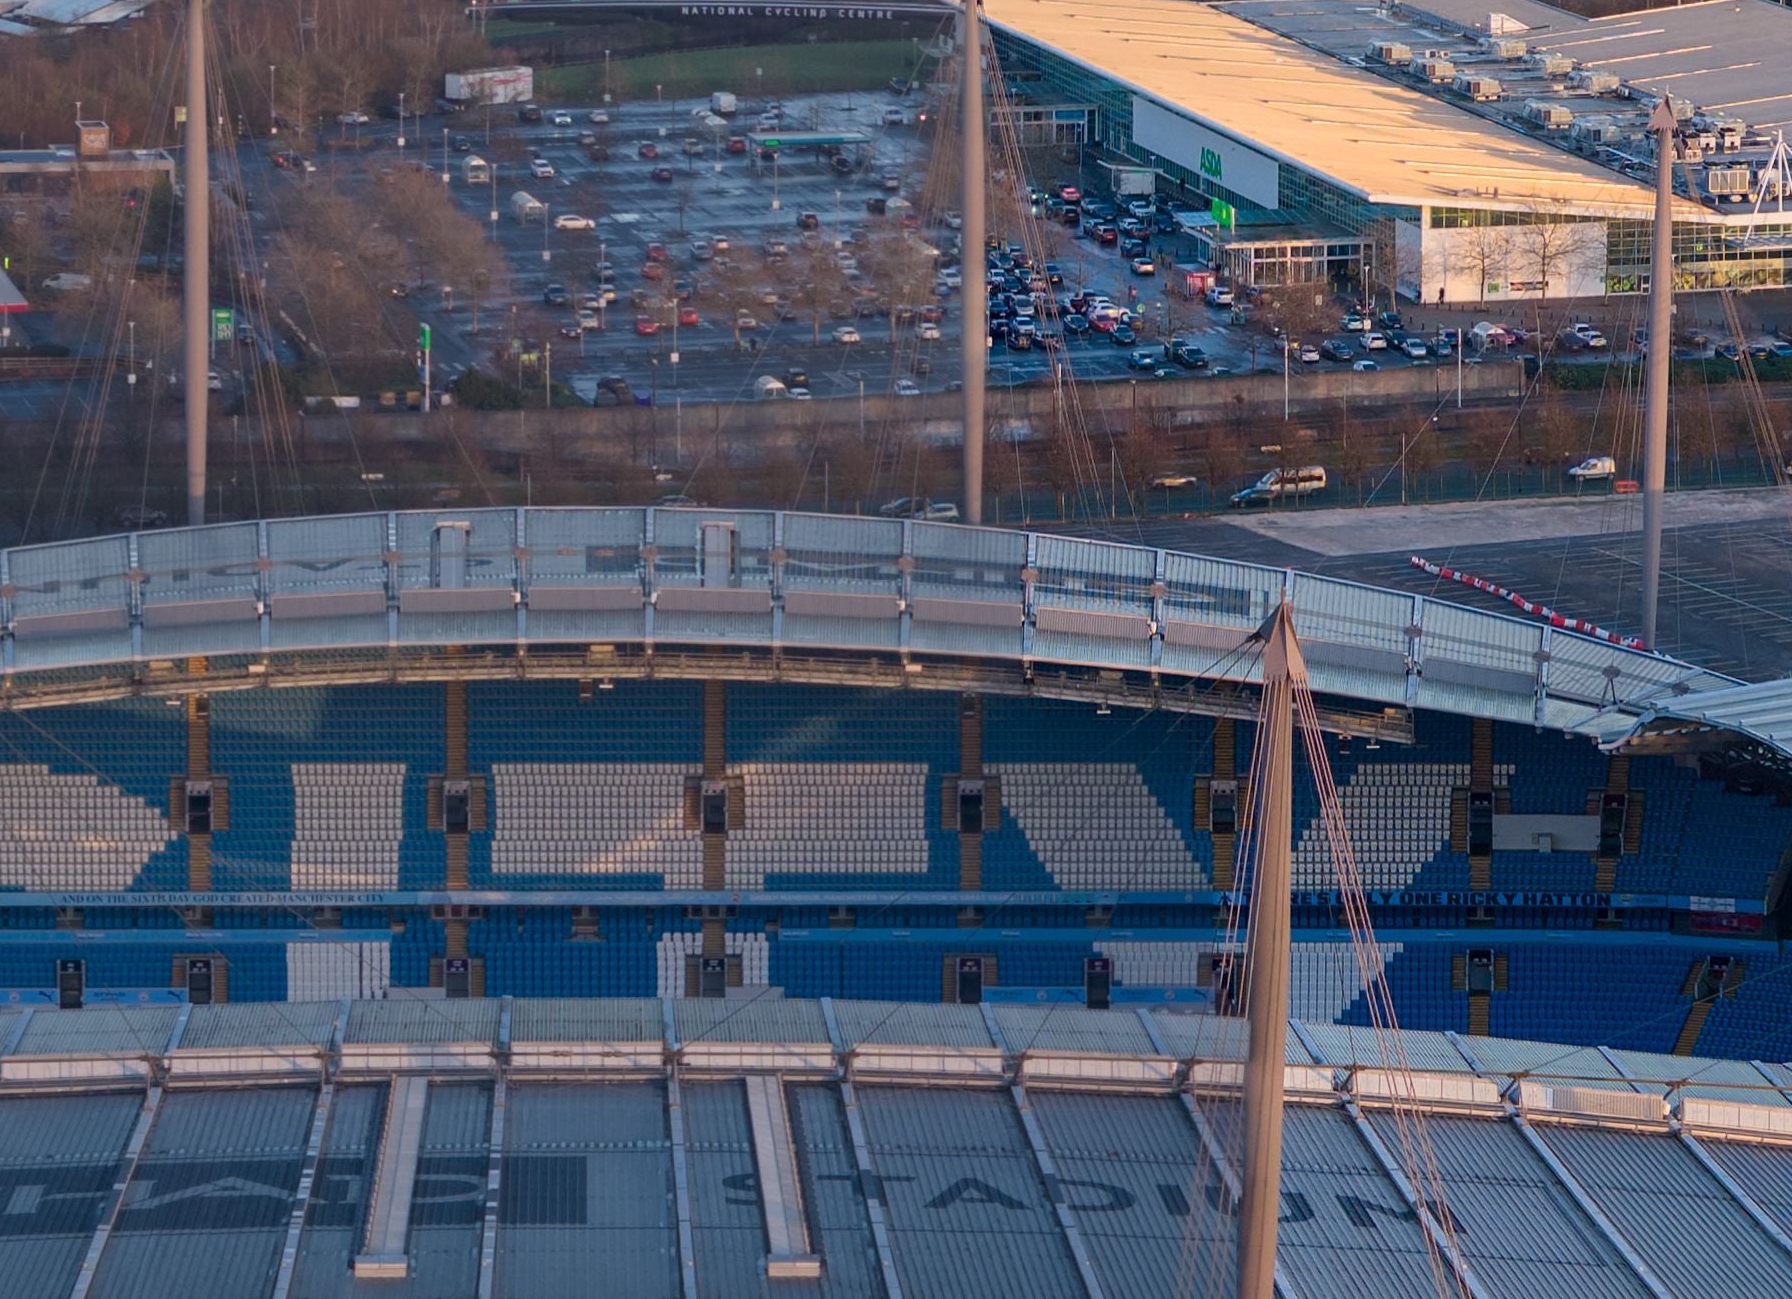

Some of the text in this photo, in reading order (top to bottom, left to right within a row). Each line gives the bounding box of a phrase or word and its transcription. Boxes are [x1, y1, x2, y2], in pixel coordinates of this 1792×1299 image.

[682, 6, 753, 16] NATIONAL
[838, 9, 893, 20] CENTRE
[1200, 146, 1222, 180] ASDA
[61, 895, 84, 903] AND
[86, 895, 103, 903] ON
[106, 895, 130, 903] THE
[169, 895, 190, 903] DAY
[192, 895, 219, 903] GOD
[278, 895, 355, 903] MANCHESTER
[357, 895, 384, 903] CITY
[1399, 891, 1611, 906] ONE RICKY HATTON
